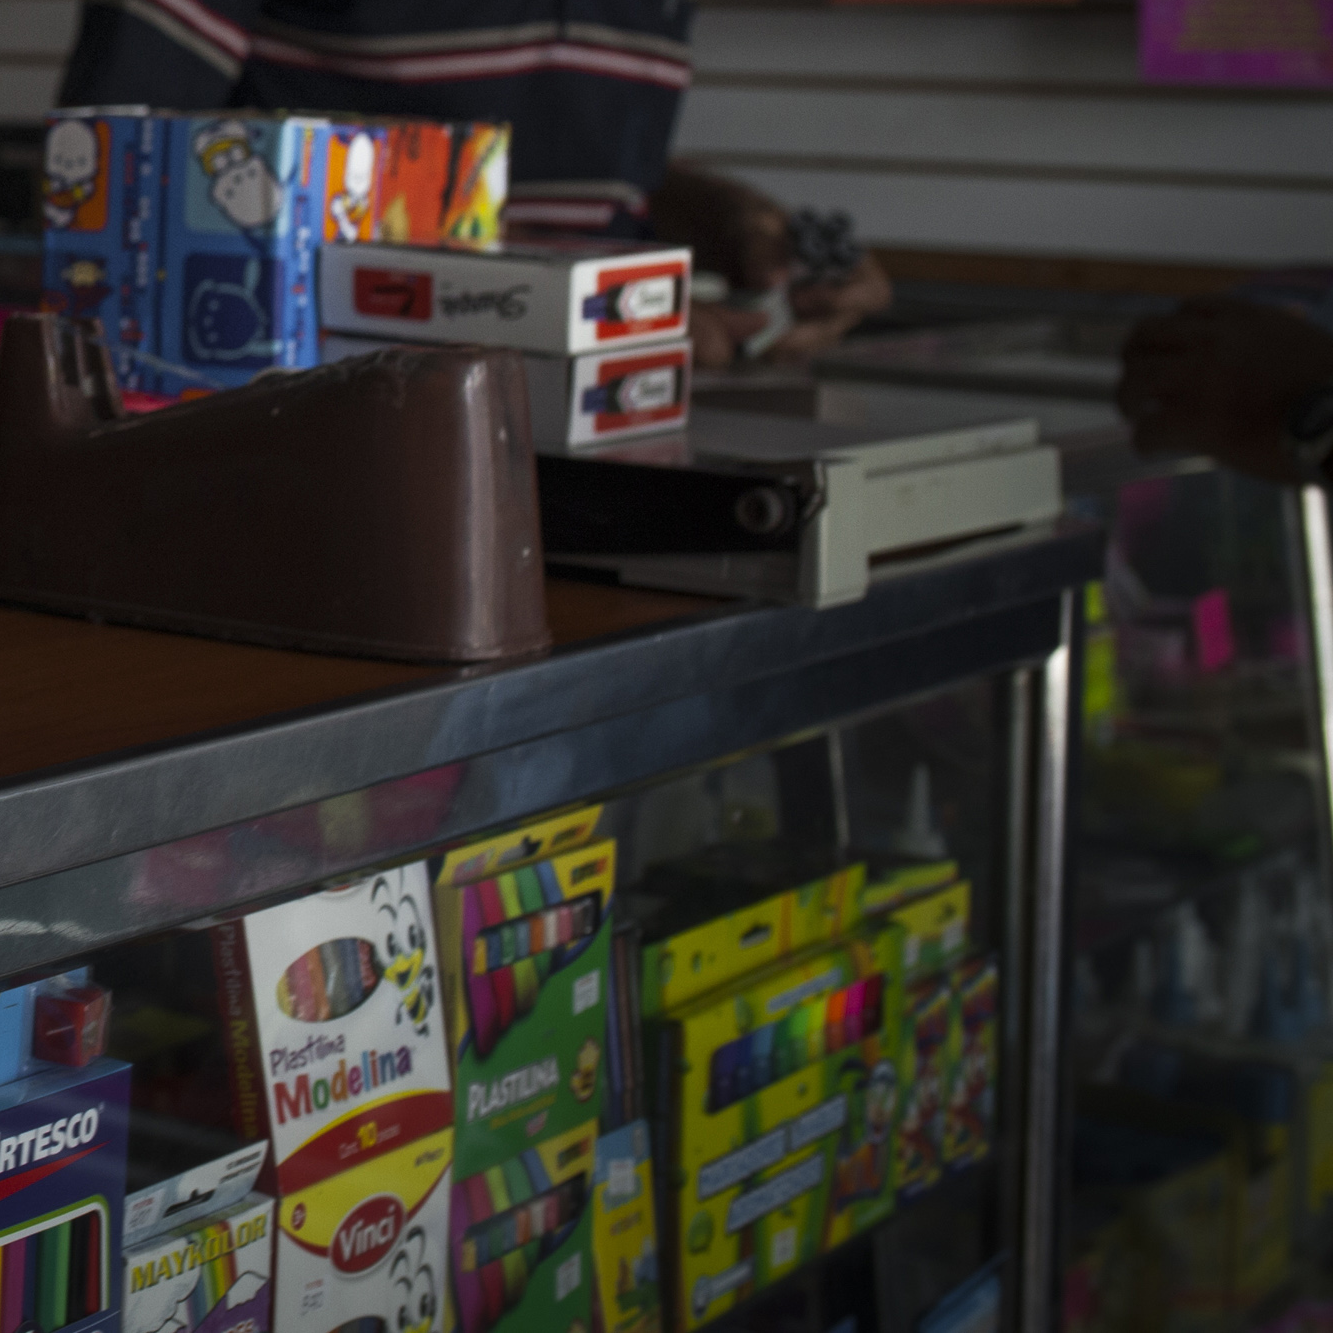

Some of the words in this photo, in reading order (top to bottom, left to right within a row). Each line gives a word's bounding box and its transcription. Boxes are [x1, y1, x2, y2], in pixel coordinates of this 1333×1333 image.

[274, 1046, 413, 1125] Modelina
[130, 1213, 268, 1295] MAYKOLOR
[338, 1202, 398, 1264] Vinci
